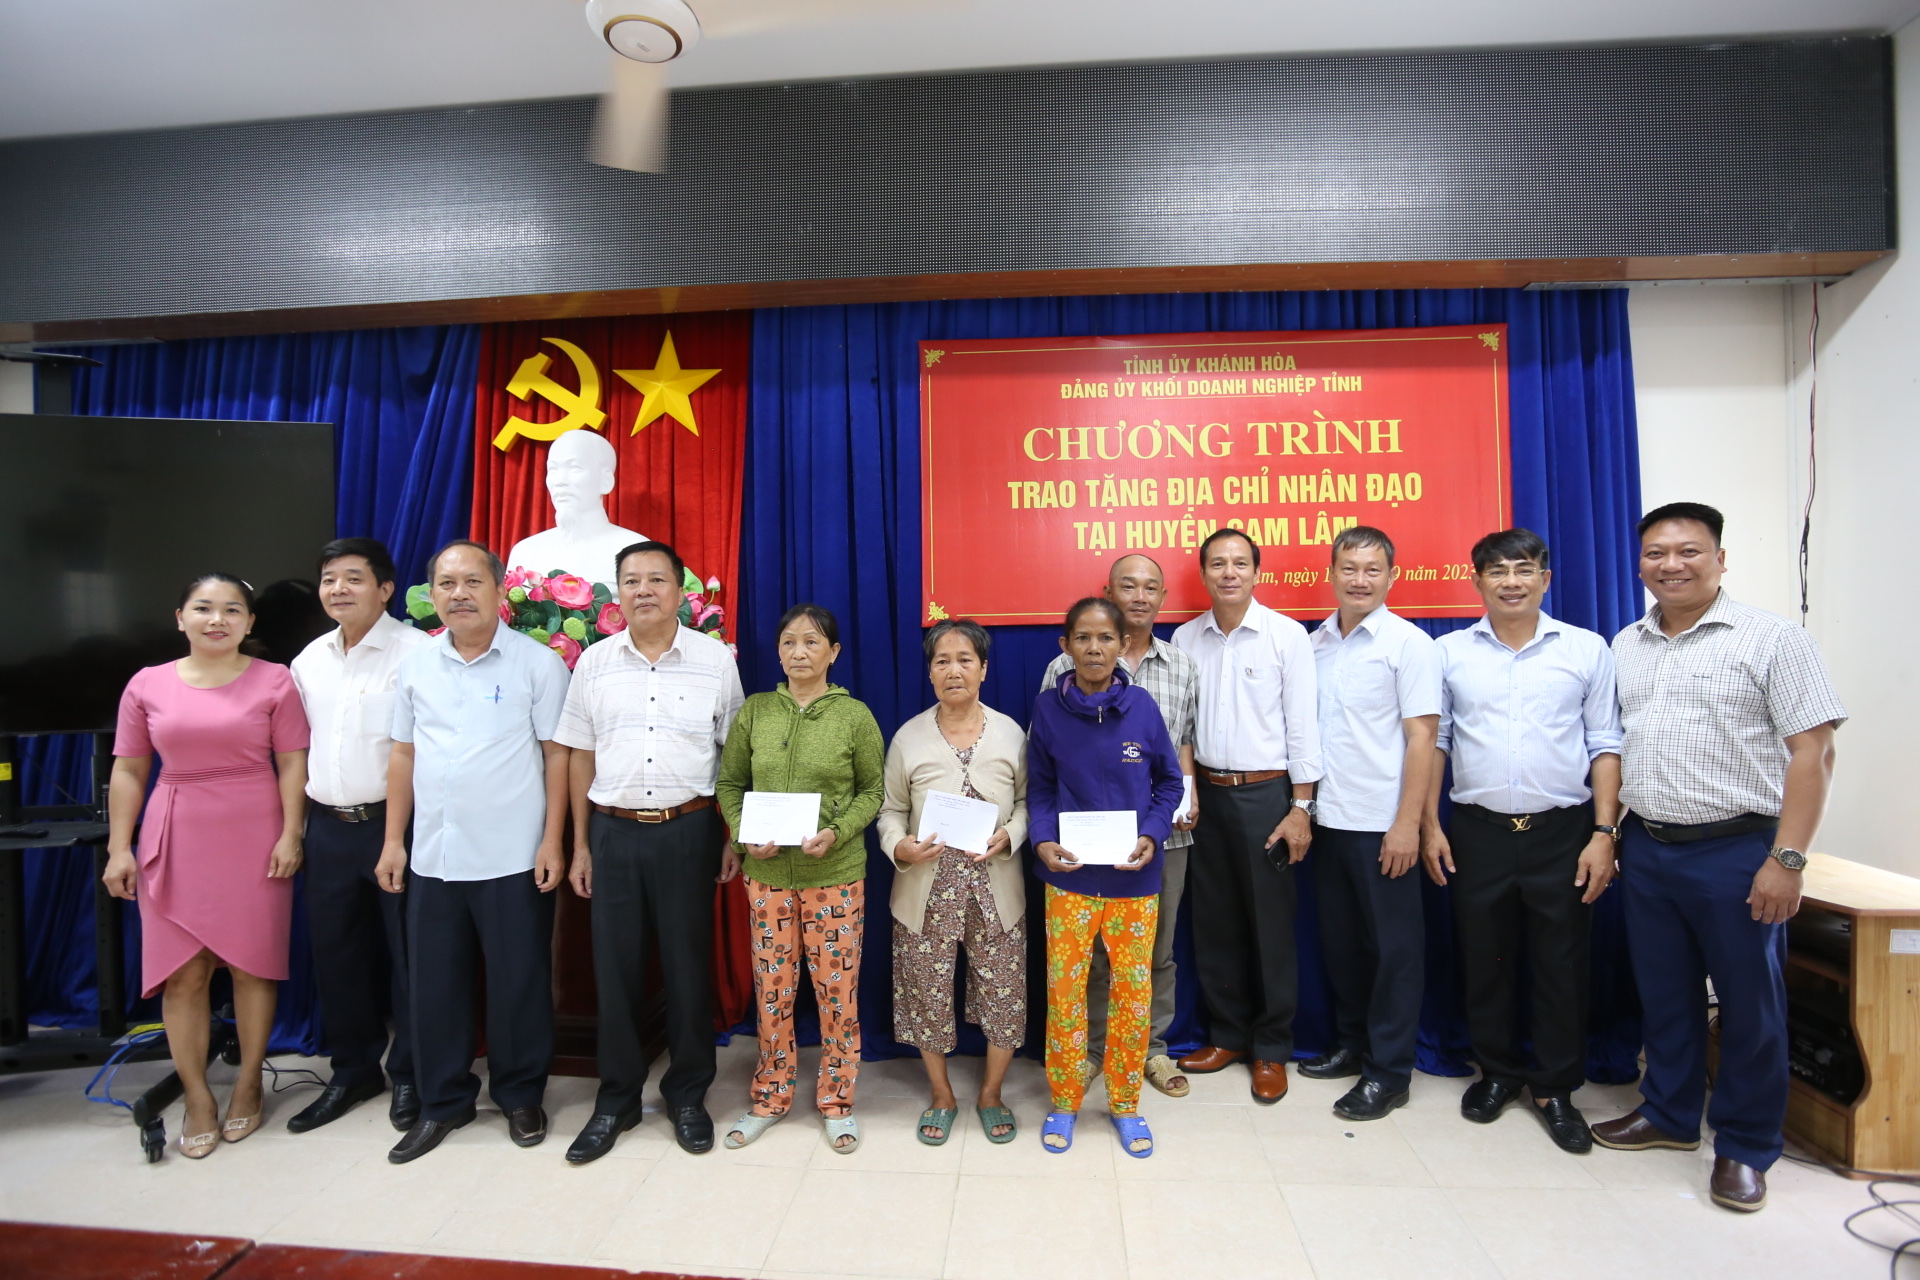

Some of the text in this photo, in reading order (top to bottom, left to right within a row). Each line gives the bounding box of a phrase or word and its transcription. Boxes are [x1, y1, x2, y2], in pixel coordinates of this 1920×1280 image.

[1123, 353, 1297, 375] TỈNH ỦY KHÁNH HÒA
[1060, 372, 1363, 399] ĐẢNG ỦY KHỐI DOANH NGHIỆP TỈNH
[1023, 409, 1404, 463] CHƯƠNG TRÌNH
[1007, 466, 1423, 514] TRAO TẶNG ĐỊA CHỈ NHÂN ĐẠO
[1073, 520, 1117, 557] TẠI
[1126, 513, 1218, 556] HUYỆN
[1284, 566, 1319, 588] ngày
[1405, 564, 1437, 581] năm
